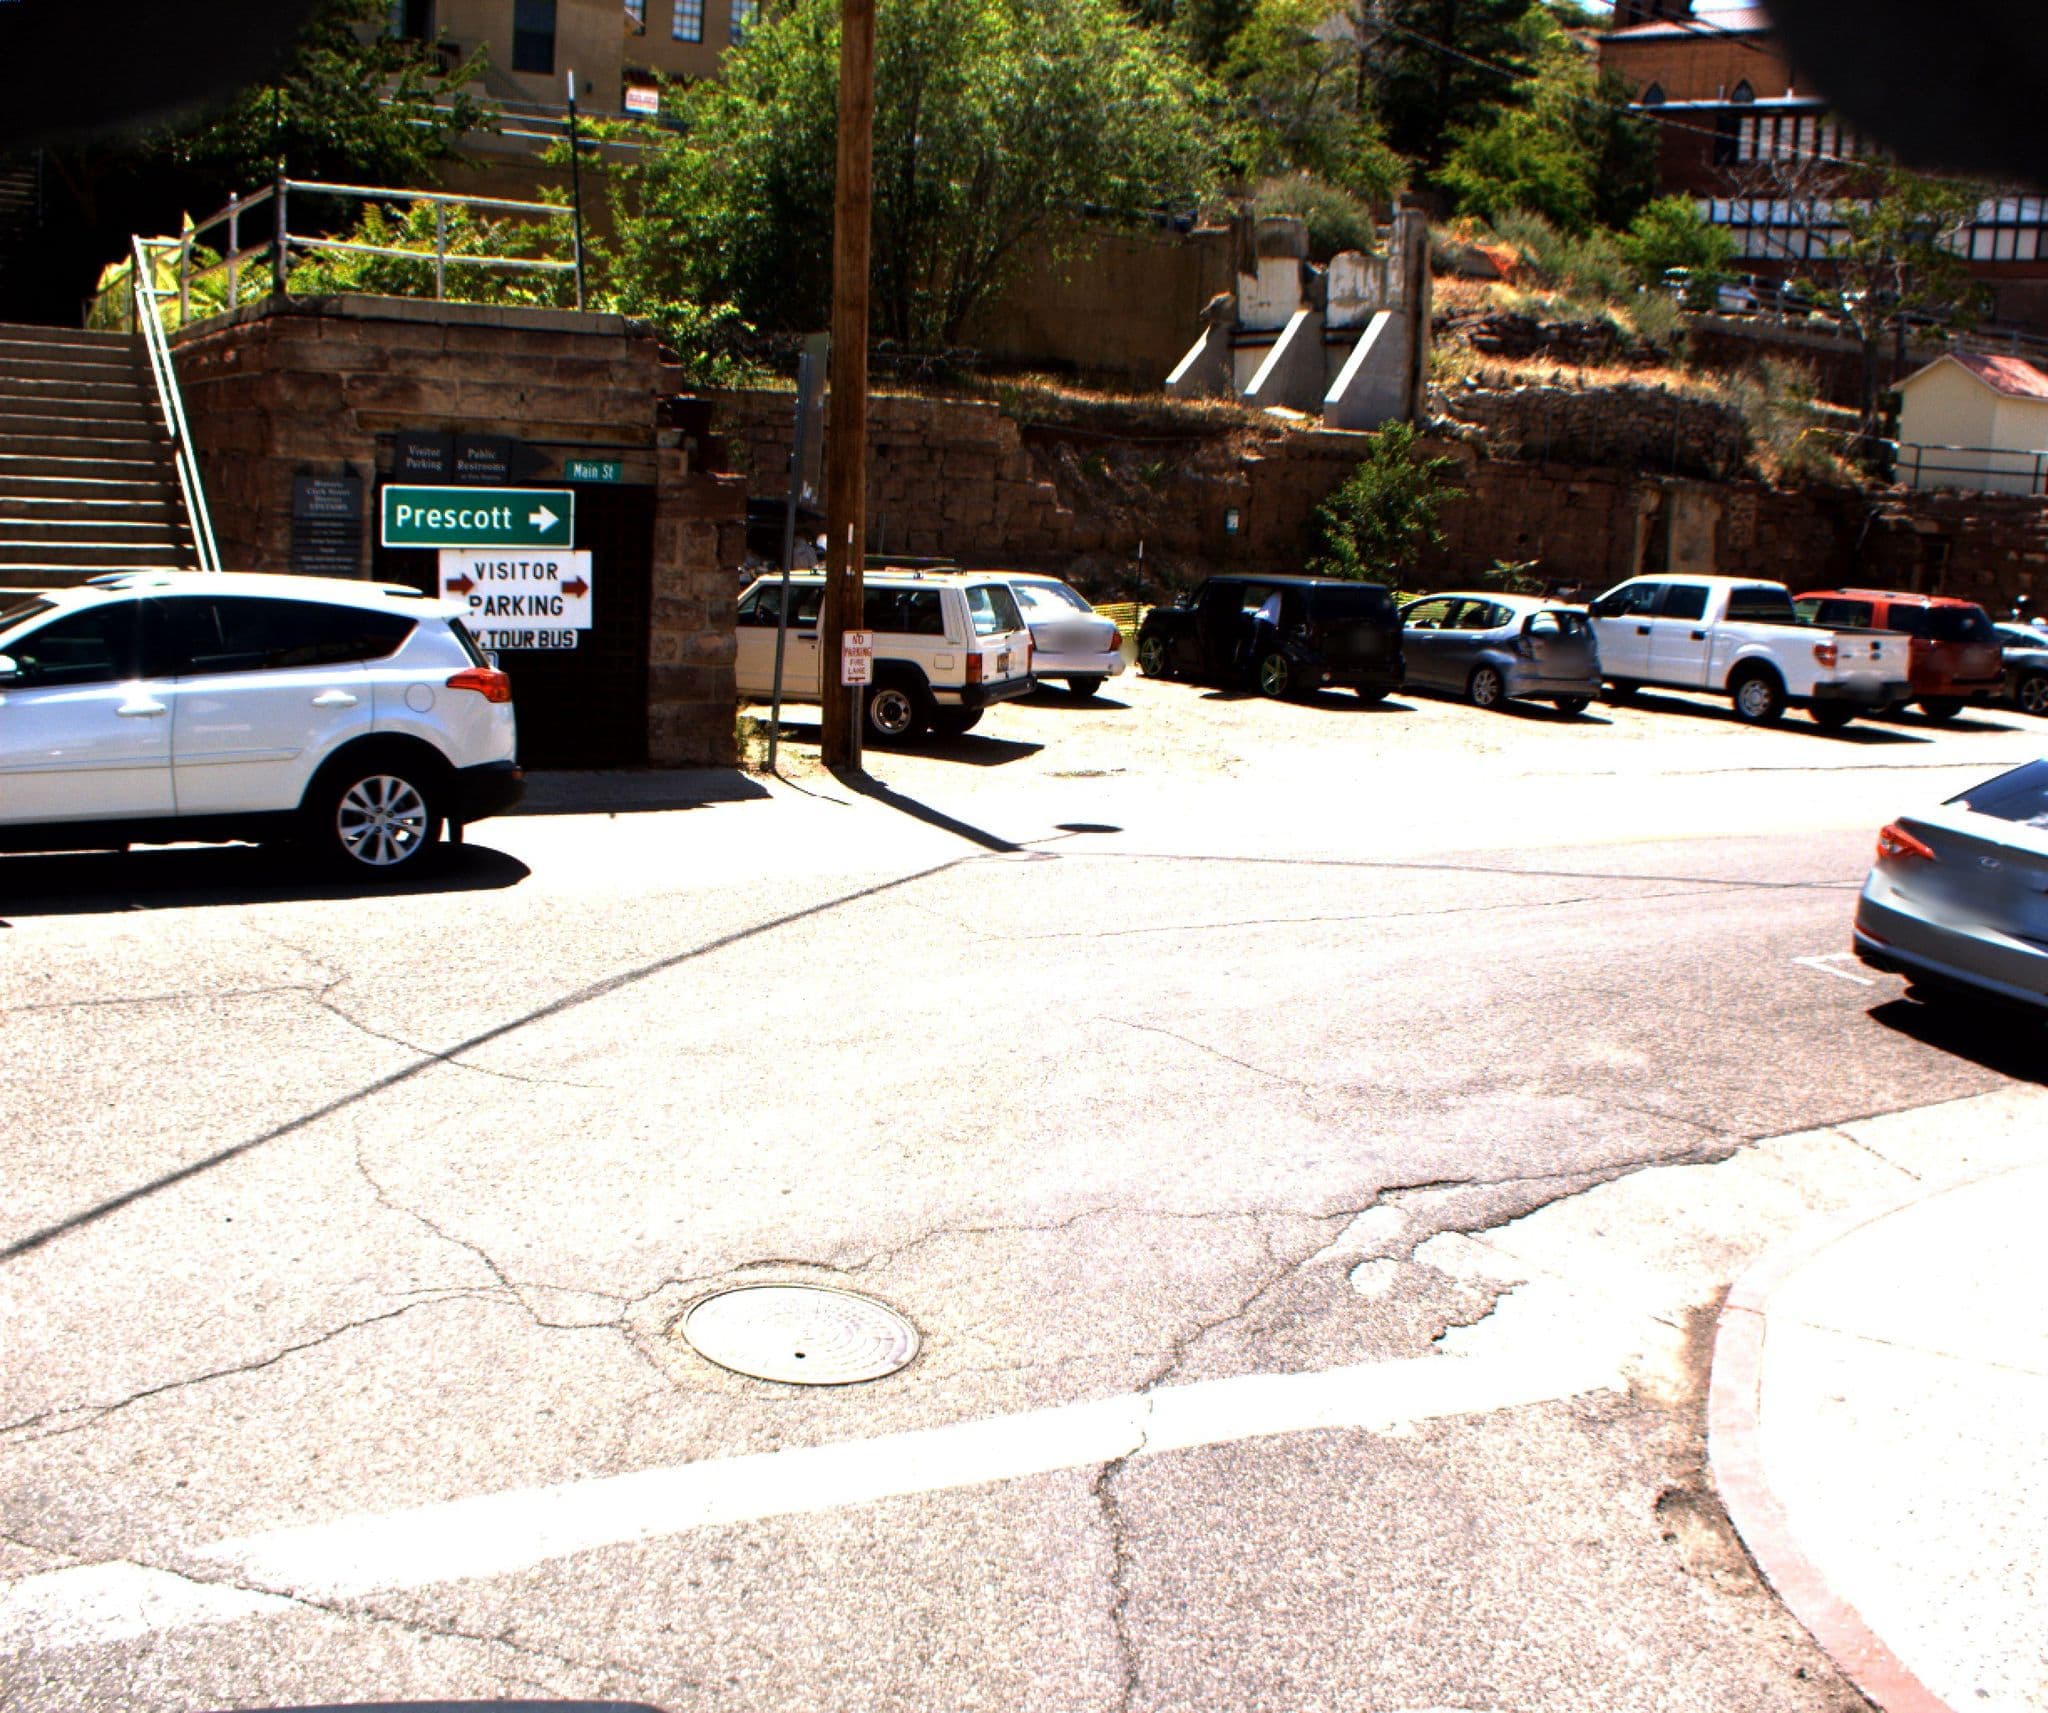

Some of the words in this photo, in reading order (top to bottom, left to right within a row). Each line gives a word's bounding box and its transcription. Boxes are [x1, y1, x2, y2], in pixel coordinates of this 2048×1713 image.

[407, 444, 440, 457] Visitor
[467, 448, 496, 460] Public
[405, 457, 442, 472] Parking
[457, 459, 506, 472] Restrooms
[573, 463, 598, 479] Main
[602, 463, 613, 479] St
[396, 504, 512, 530] Prescott
[475, 562, 558, 580] VISITOR
[469, 595, 564, 617] PARKING
[538, 630, 574, 649] BUS
[852, 635, 864, 644] NO
[844, 647, 872, 656] PARKING
